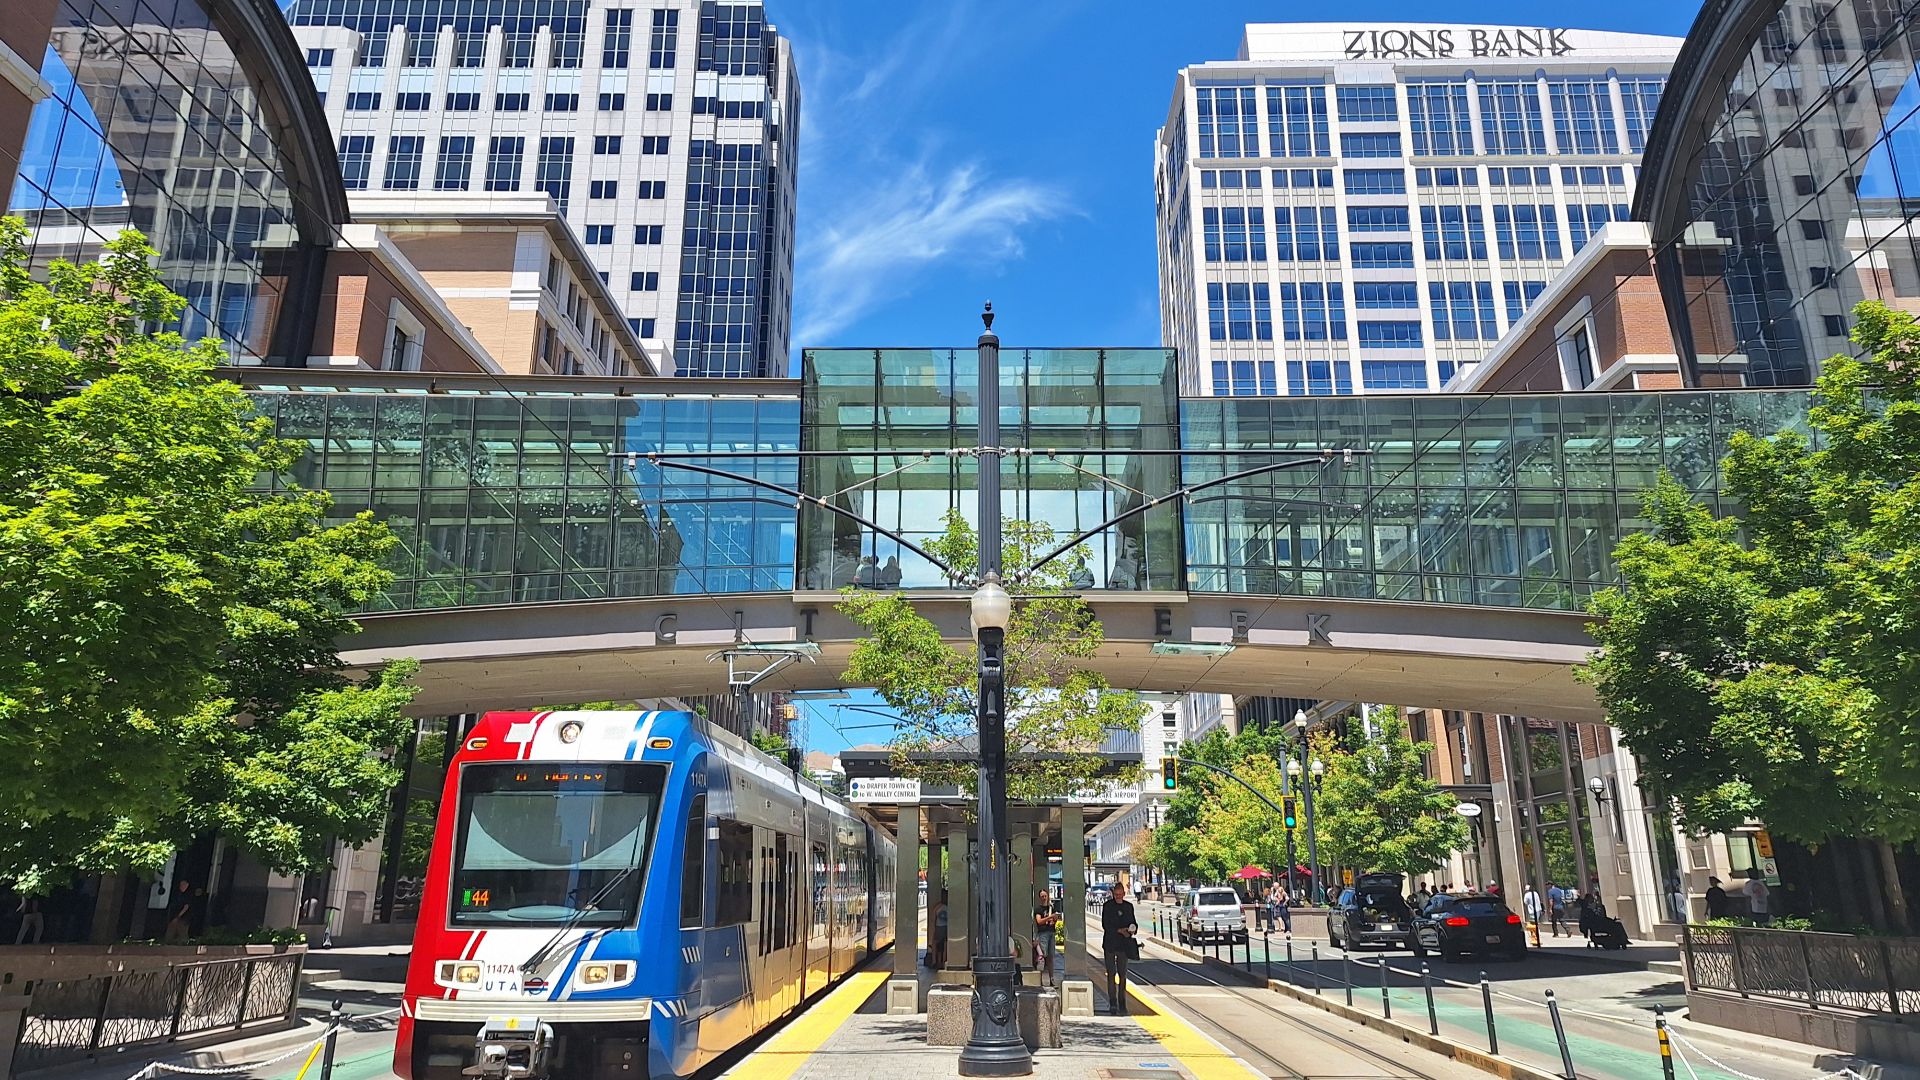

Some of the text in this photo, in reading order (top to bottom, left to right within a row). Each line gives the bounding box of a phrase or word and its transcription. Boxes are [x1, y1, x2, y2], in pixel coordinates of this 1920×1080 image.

[1343, 28, 1577, 54] ZIONS BANK
[1114, 791, 1137, 799] AIRPORT
[472, 890, 489, 907] 44
[487, 964, 515, 975] 1147A
[485, 981, 518, 991] UTA
